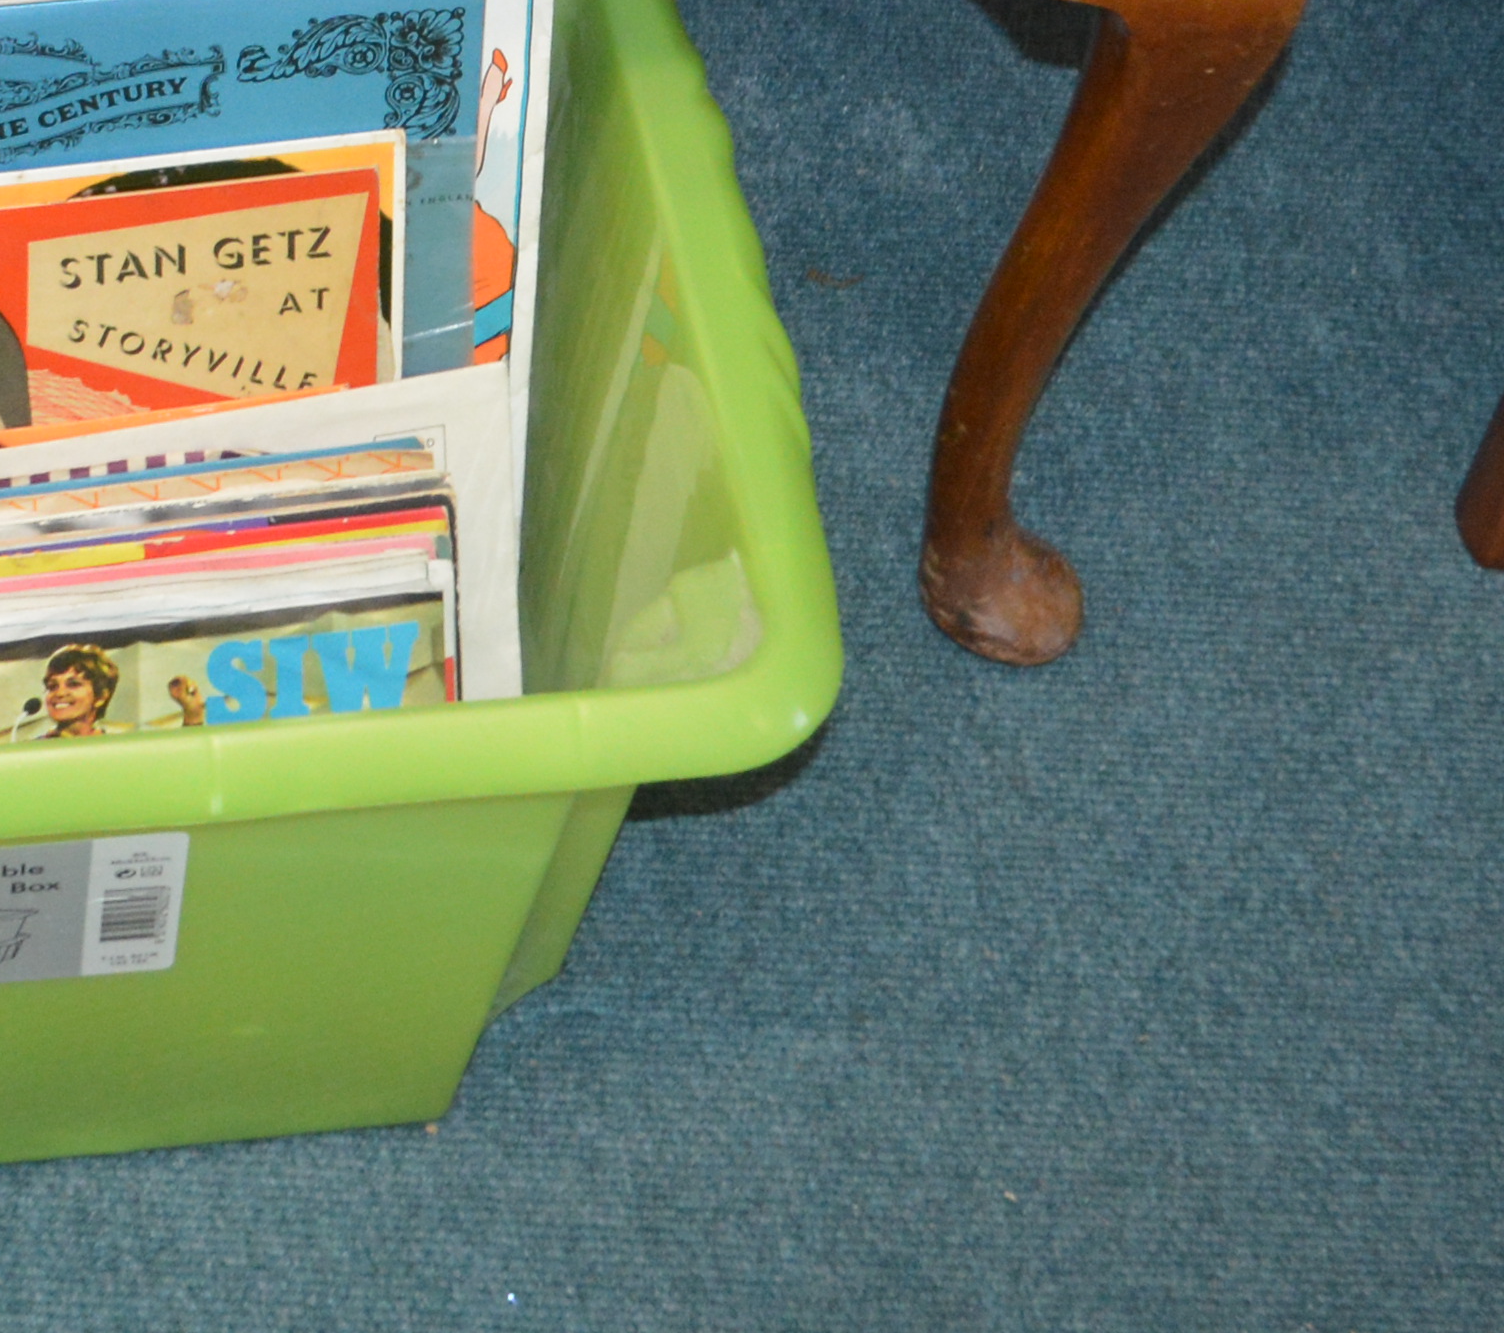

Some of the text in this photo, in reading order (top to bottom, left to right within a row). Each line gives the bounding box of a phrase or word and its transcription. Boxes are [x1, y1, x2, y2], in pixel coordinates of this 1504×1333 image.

[35, 75, 190, 129] CENTURY
[59, 224, 333, 290] STAN GETZ
[277, 286, 331, 316] AT
[67, 318, 319, 391] STORYVILLE
[205, 620, 421, 727] SIW
[8, 878, 62, 895] Box
